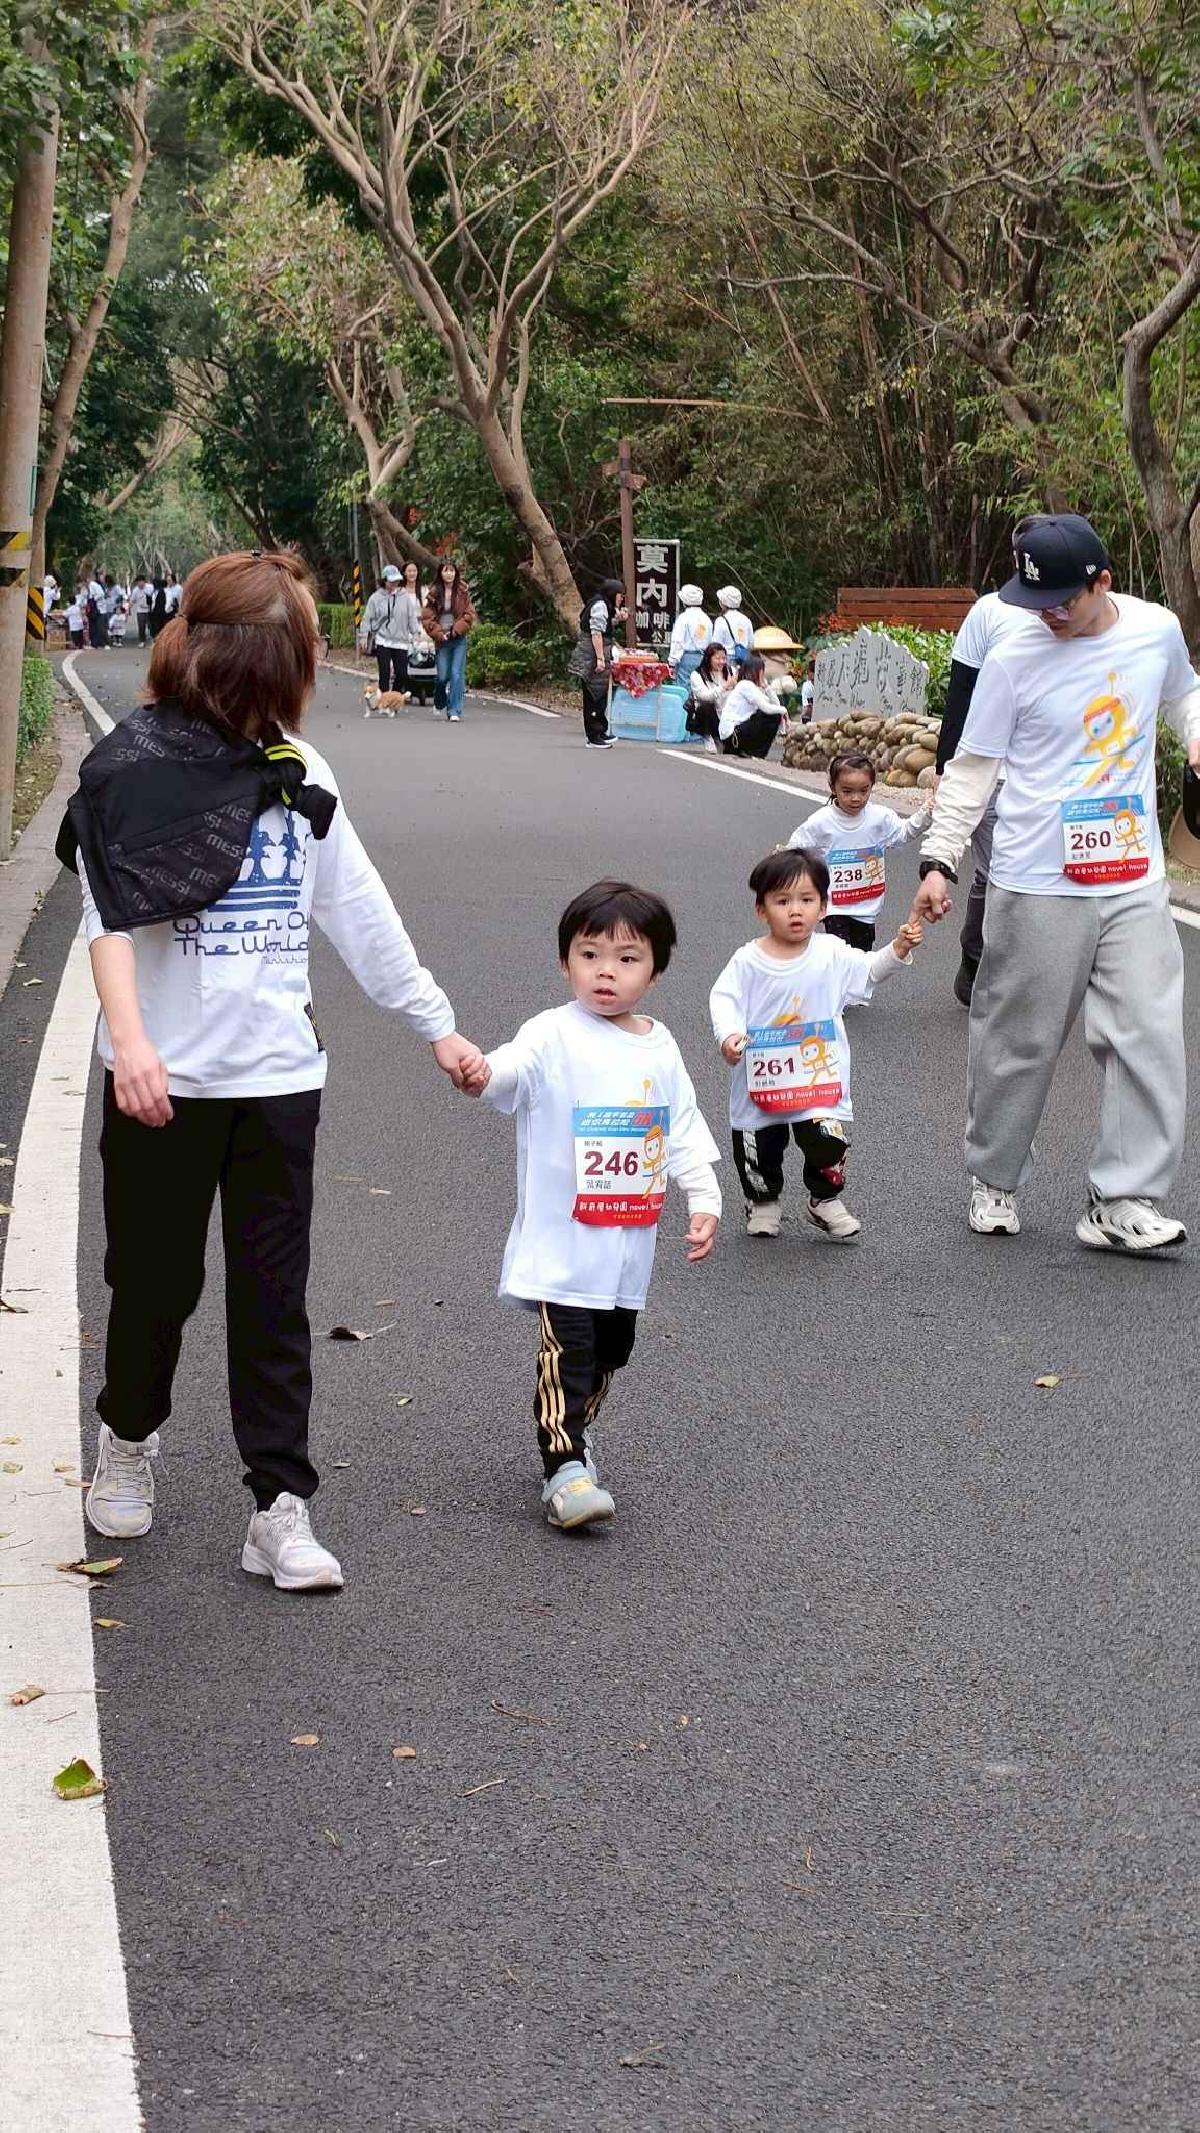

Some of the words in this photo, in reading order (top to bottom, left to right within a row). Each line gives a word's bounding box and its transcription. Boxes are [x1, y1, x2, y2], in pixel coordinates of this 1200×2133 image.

[636, 544, 669, 608] 莫內
[1024, 553, 1040, 581] LA
[636, 610, 670, 630] 咖啡
[1070, 830, 1111, 851] 260
[834, 869, 863, 883] 238
[173, 914, 282, 938] Queen
[173, 937, 240, 956] The
[753, 1057, 795, 1077] 261
[584, 1151, 639, 1176] 246
